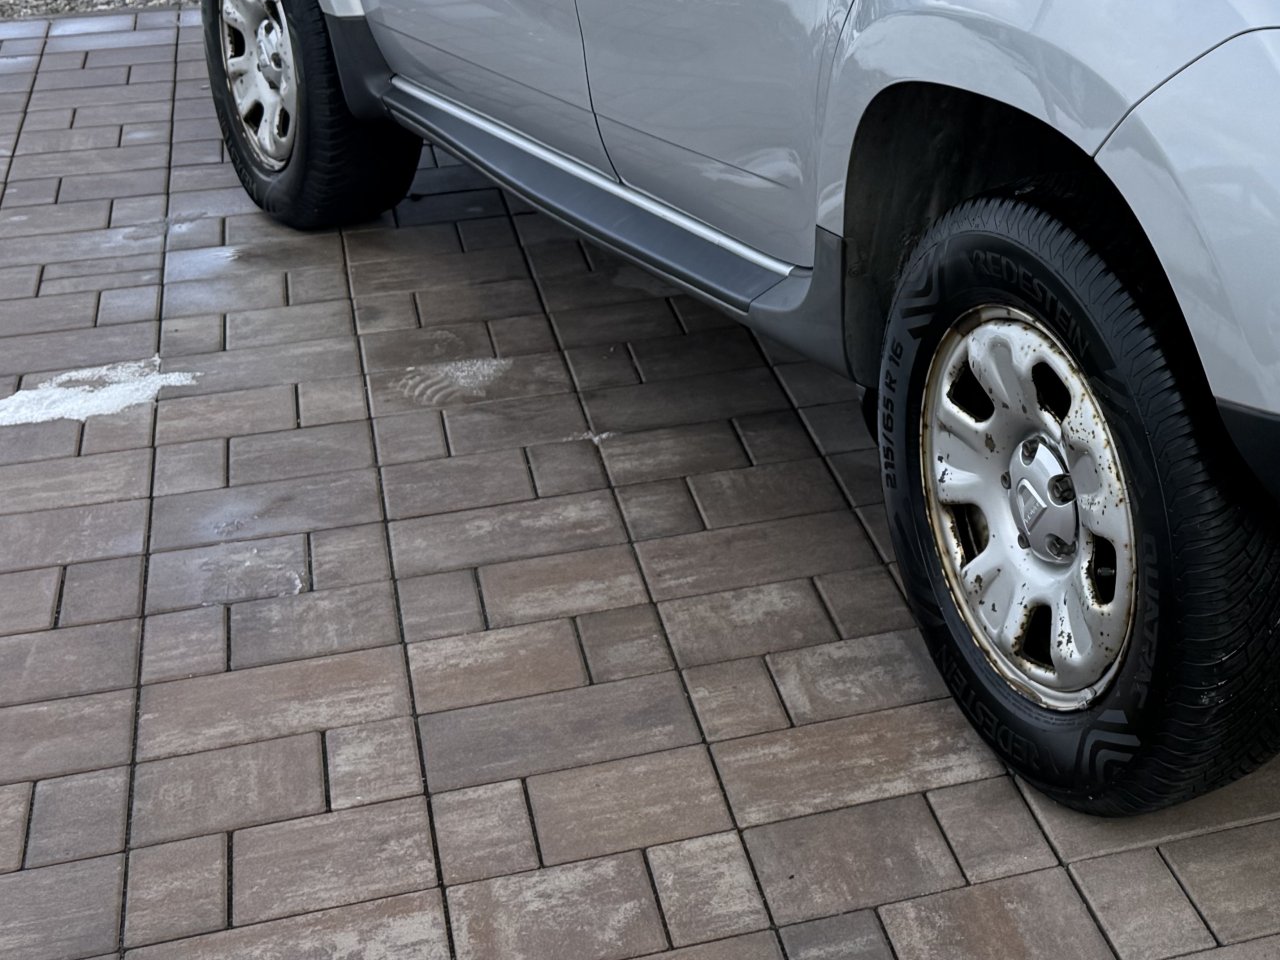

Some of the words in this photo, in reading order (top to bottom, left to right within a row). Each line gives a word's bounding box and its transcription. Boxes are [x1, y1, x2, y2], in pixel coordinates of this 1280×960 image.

[888, 338, 905, 369] 16
[884, 372, 899, 390] R
[881, 396, 899, 490] 215/65
